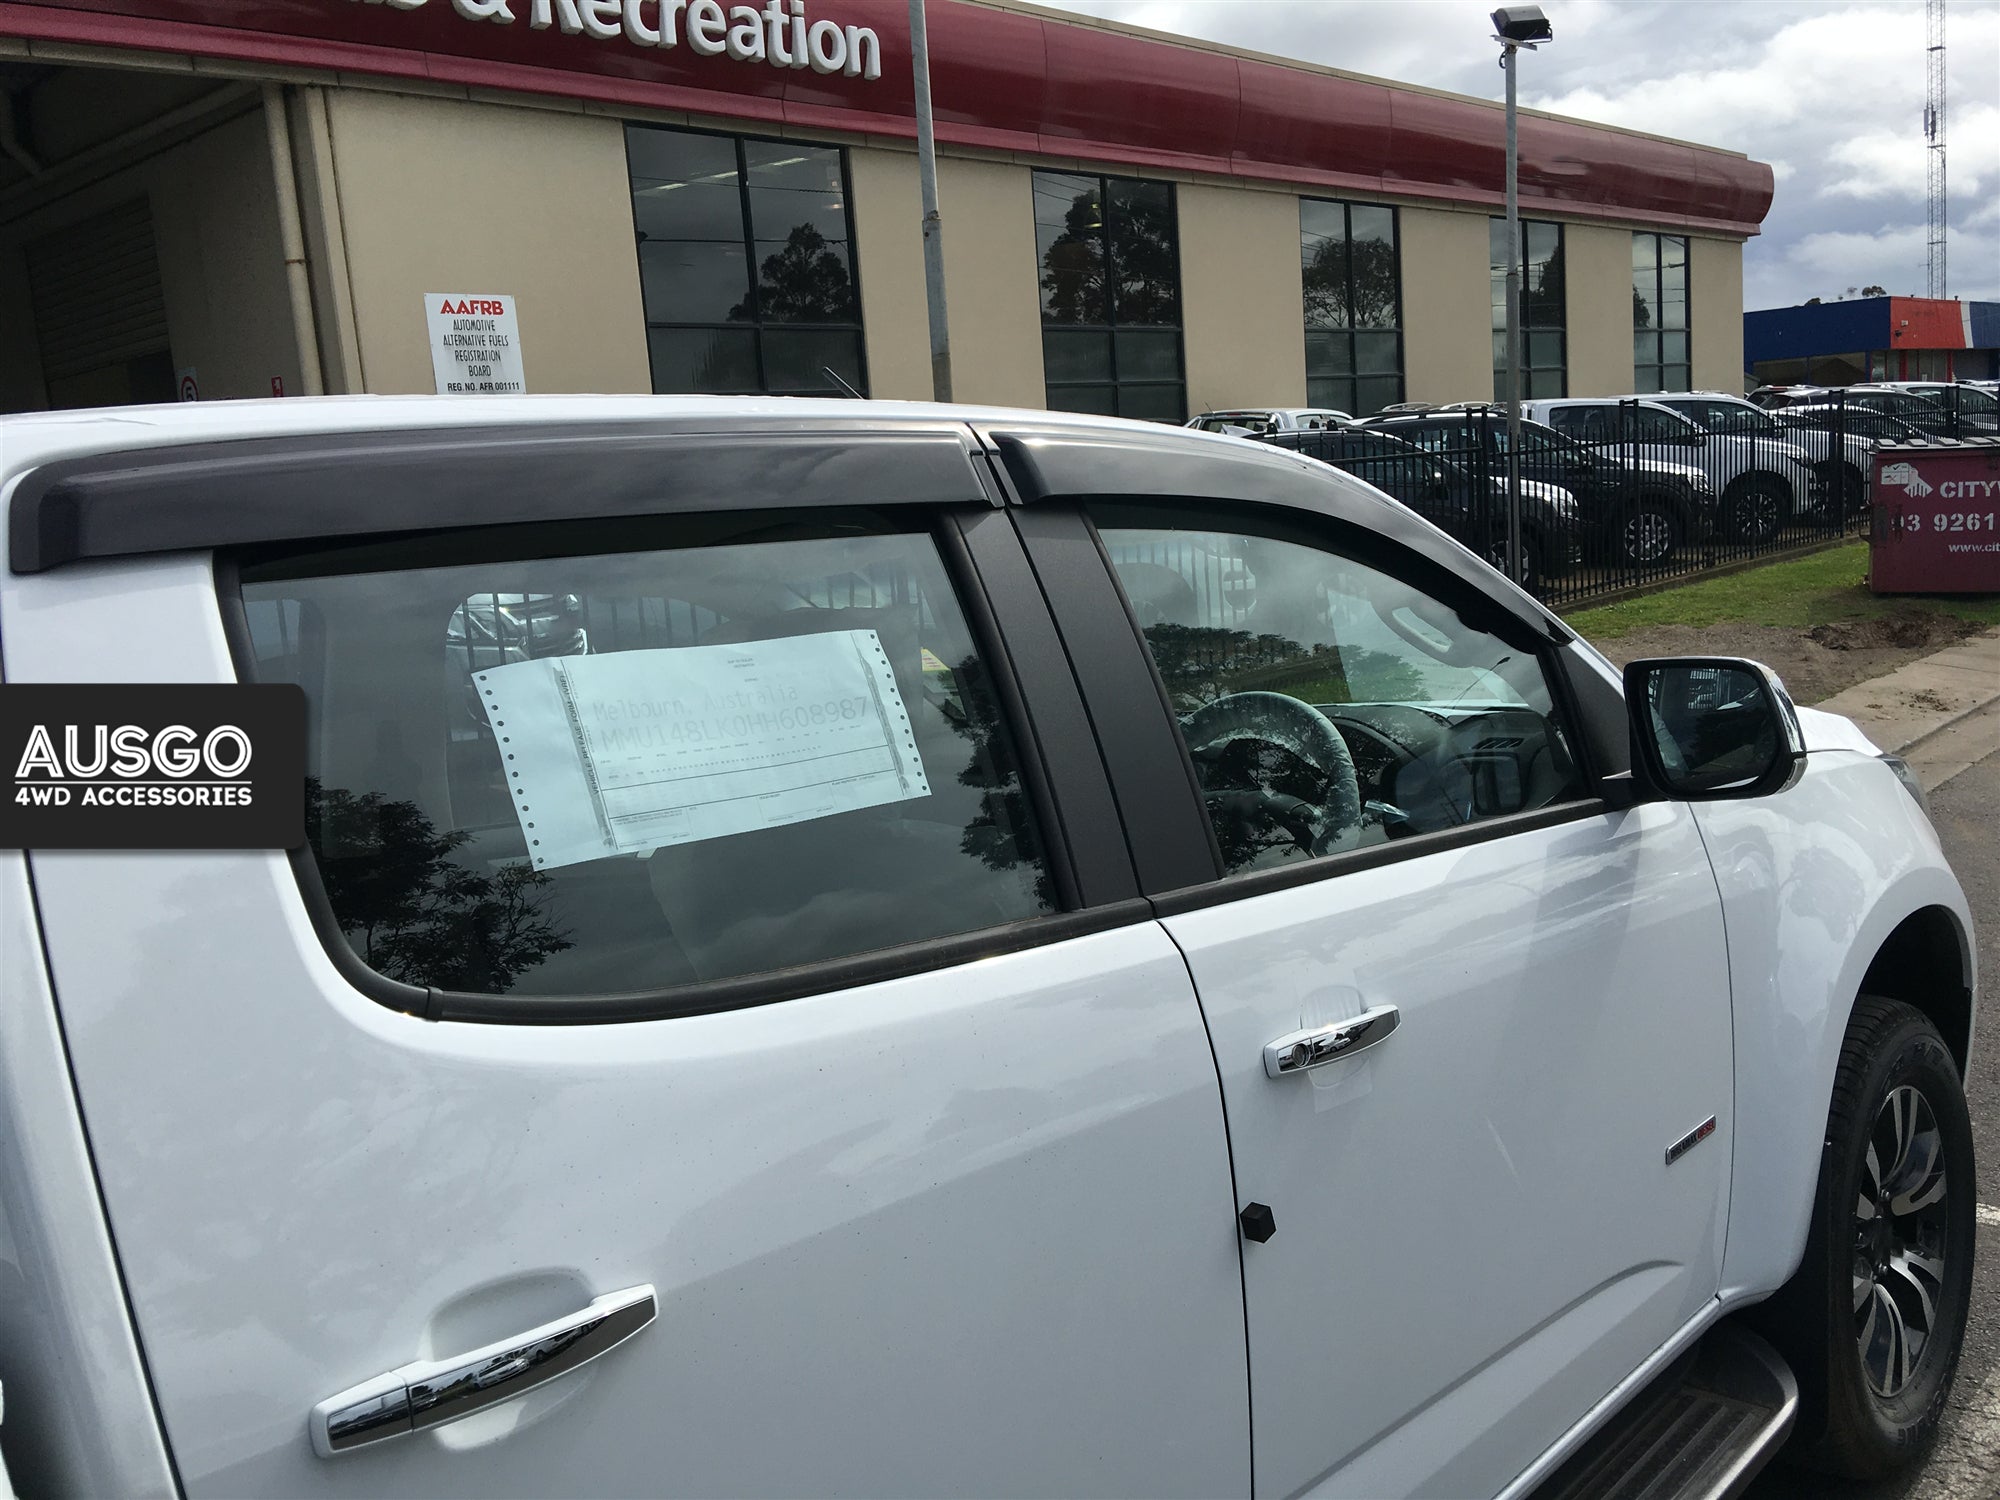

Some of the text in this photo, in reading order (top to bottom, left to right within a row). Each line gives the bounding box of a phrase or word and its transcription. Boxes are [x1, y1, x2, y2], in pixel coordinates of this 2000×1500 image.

[440, 299, 504, 315] AAFRB
[453, 319, 496, 332] AUTOMOTIVE
[443, 334, 509, 347] ALTERNATIVE FUELS
[454, 349, 501, 362] REGISTRATION
[468, 365, 491, 377] BOARD
[479, 382, 494, 391] AFR
[1940, 480, 2000, 498] CITY
[1933, 512, 1994, 532] 9261
[704, 684, 799, 713] Australia
